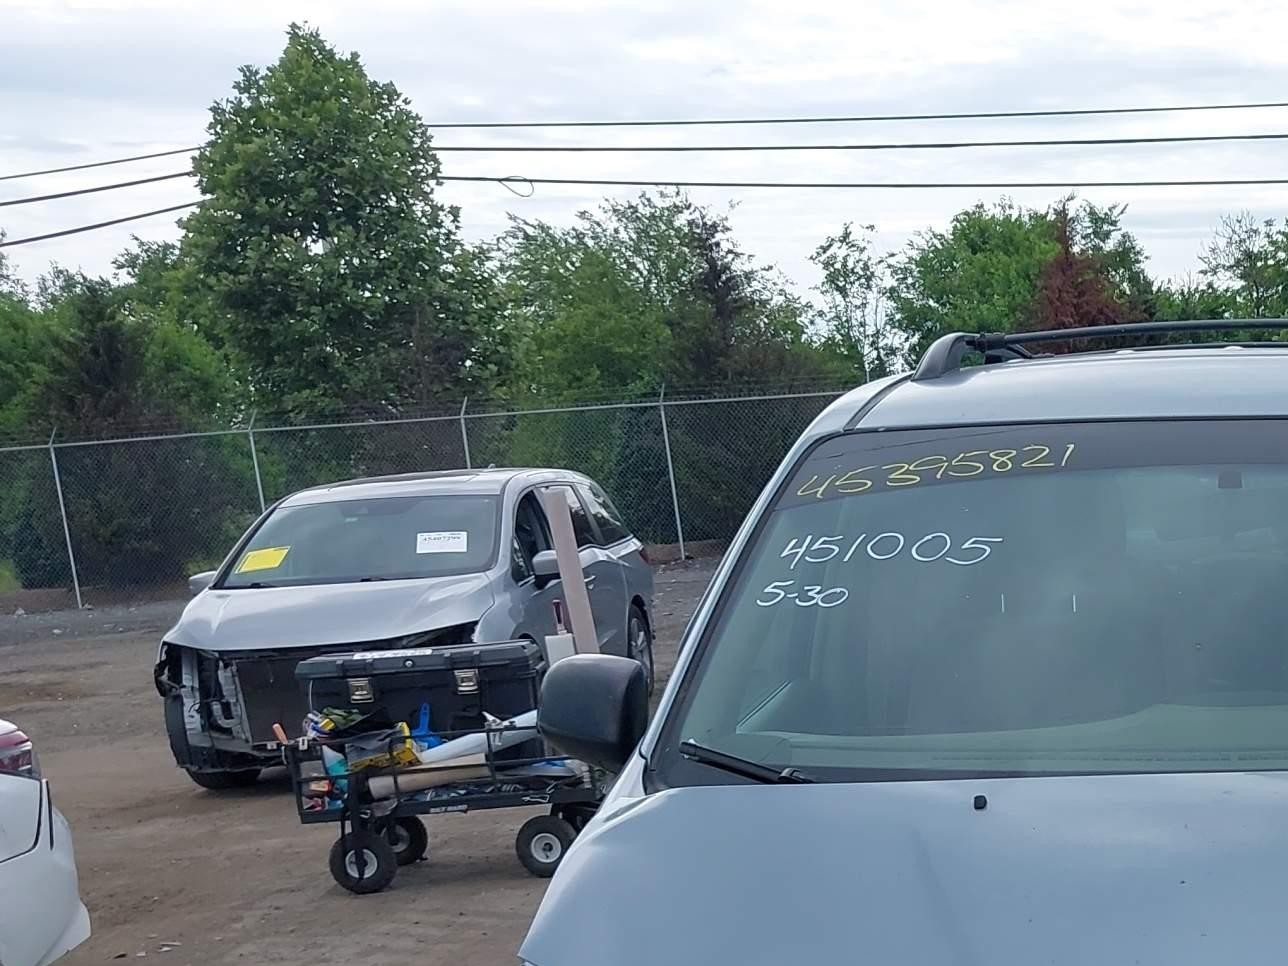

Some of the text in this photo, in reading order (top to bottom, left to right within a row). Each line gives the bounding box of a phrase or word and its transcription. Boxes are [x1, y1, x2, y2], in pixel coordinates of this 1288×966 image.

[797, 444, 1075, 498] 45395821
[780, 533, 1004, 569] 451005
[756, 580, 849, 608] 5-30
